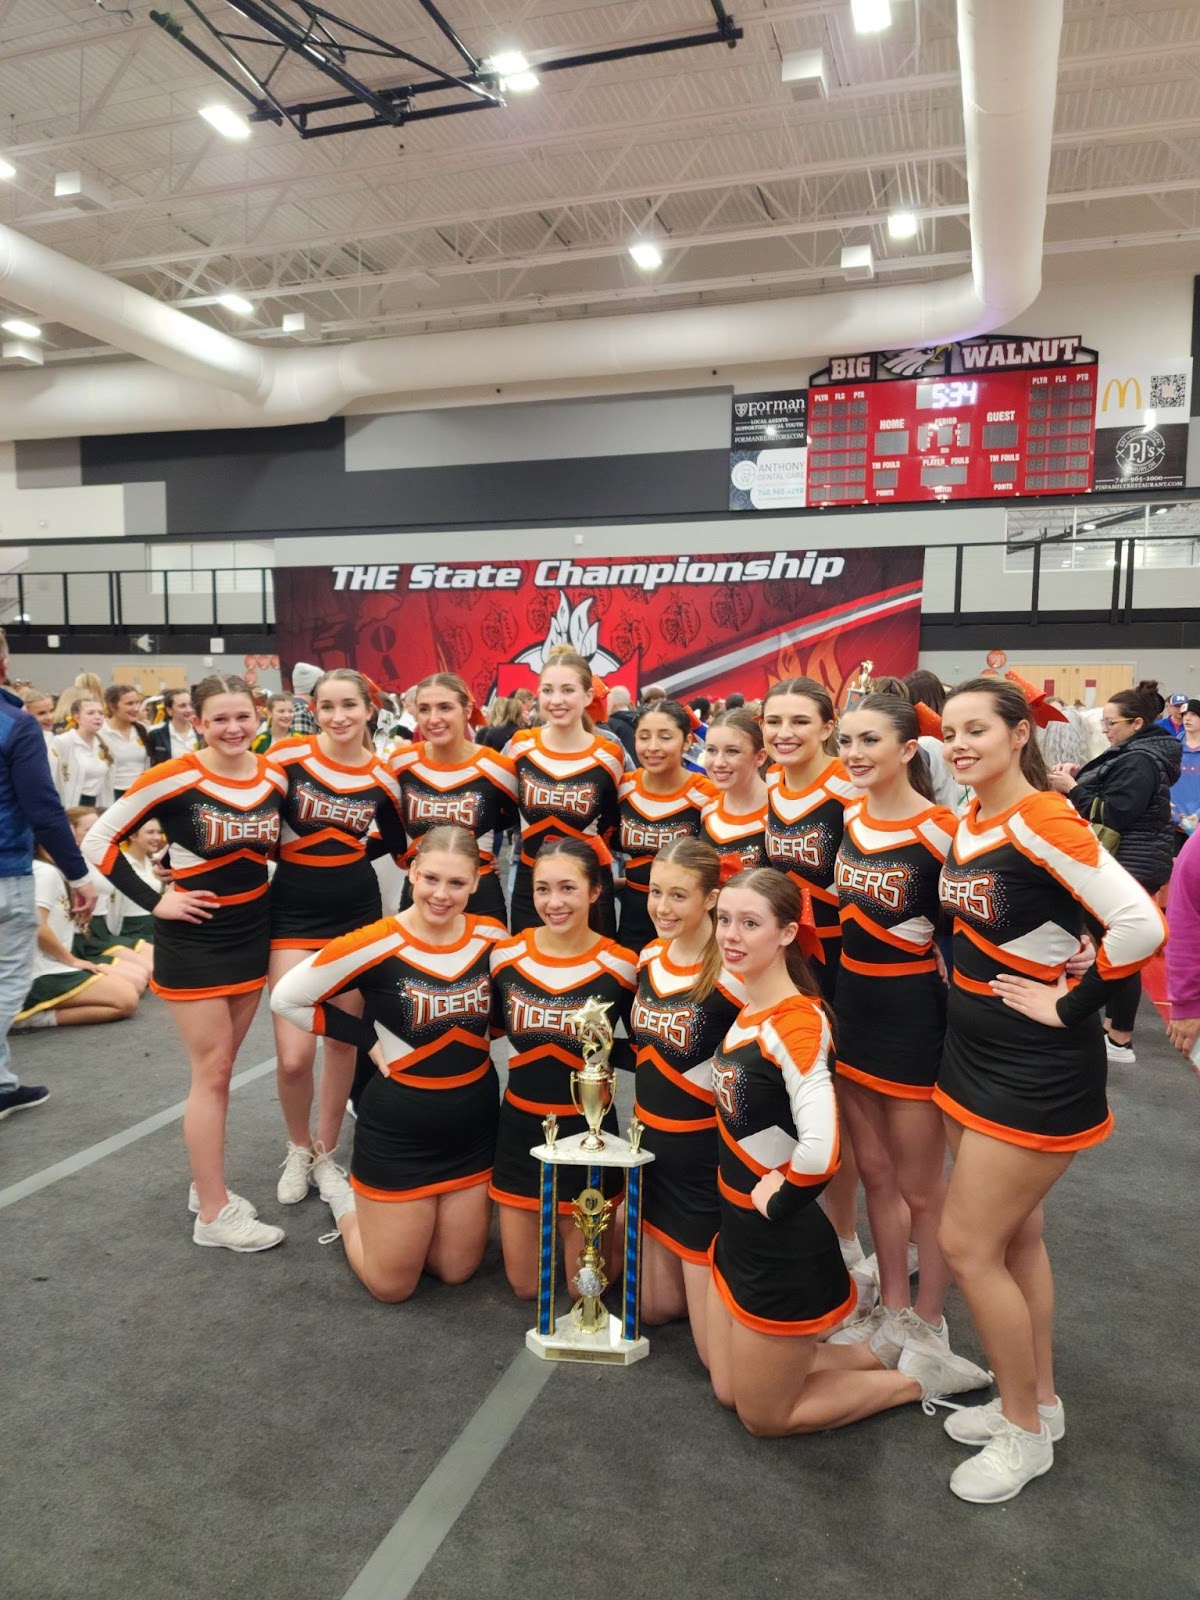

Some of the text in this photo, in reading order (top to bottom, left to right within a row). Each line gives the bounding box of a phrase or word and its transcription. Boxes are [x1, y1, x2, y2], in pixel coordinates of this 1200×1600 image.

[830, 337, 1079, 381] BIG WALNUT
[1032, 377, 1048, 385] PLYR
[1055, 375, 1067, 383] FLS
[1076, 373, 1089, 381] PTS
[815, 394, 829, 402] PLYR
[835, 392, 846, 400] FLS
[853, 391, 865, 399] PTS
[748, 399, 805, 417] Forman
[987, 410, 1016, 422] GUEST
[880, 419, 905, 430] HOME
[1001, 453, 1020, 461] FOULS
[1127, 439, 1155, 464] PJ's
[758, 462, 804, 472] ANTHONY
[882, 461, 900, 469] FOULS
[922, 457, 969, 467] PLAYER FOULS
[757, 473, 785, 481] DENTAL
[332, 551, 845, 591] THE State Championship
[522, 777, 594, 816] TIGERS
[298, 788, 376, 833] TIGERS
[406, 791, 477, 828] TIGERS
[202, 811, 280, 848] TIGERS
[939, 874, 994, 922] GERS
[409, 979, 490, 1027] TIGERS
